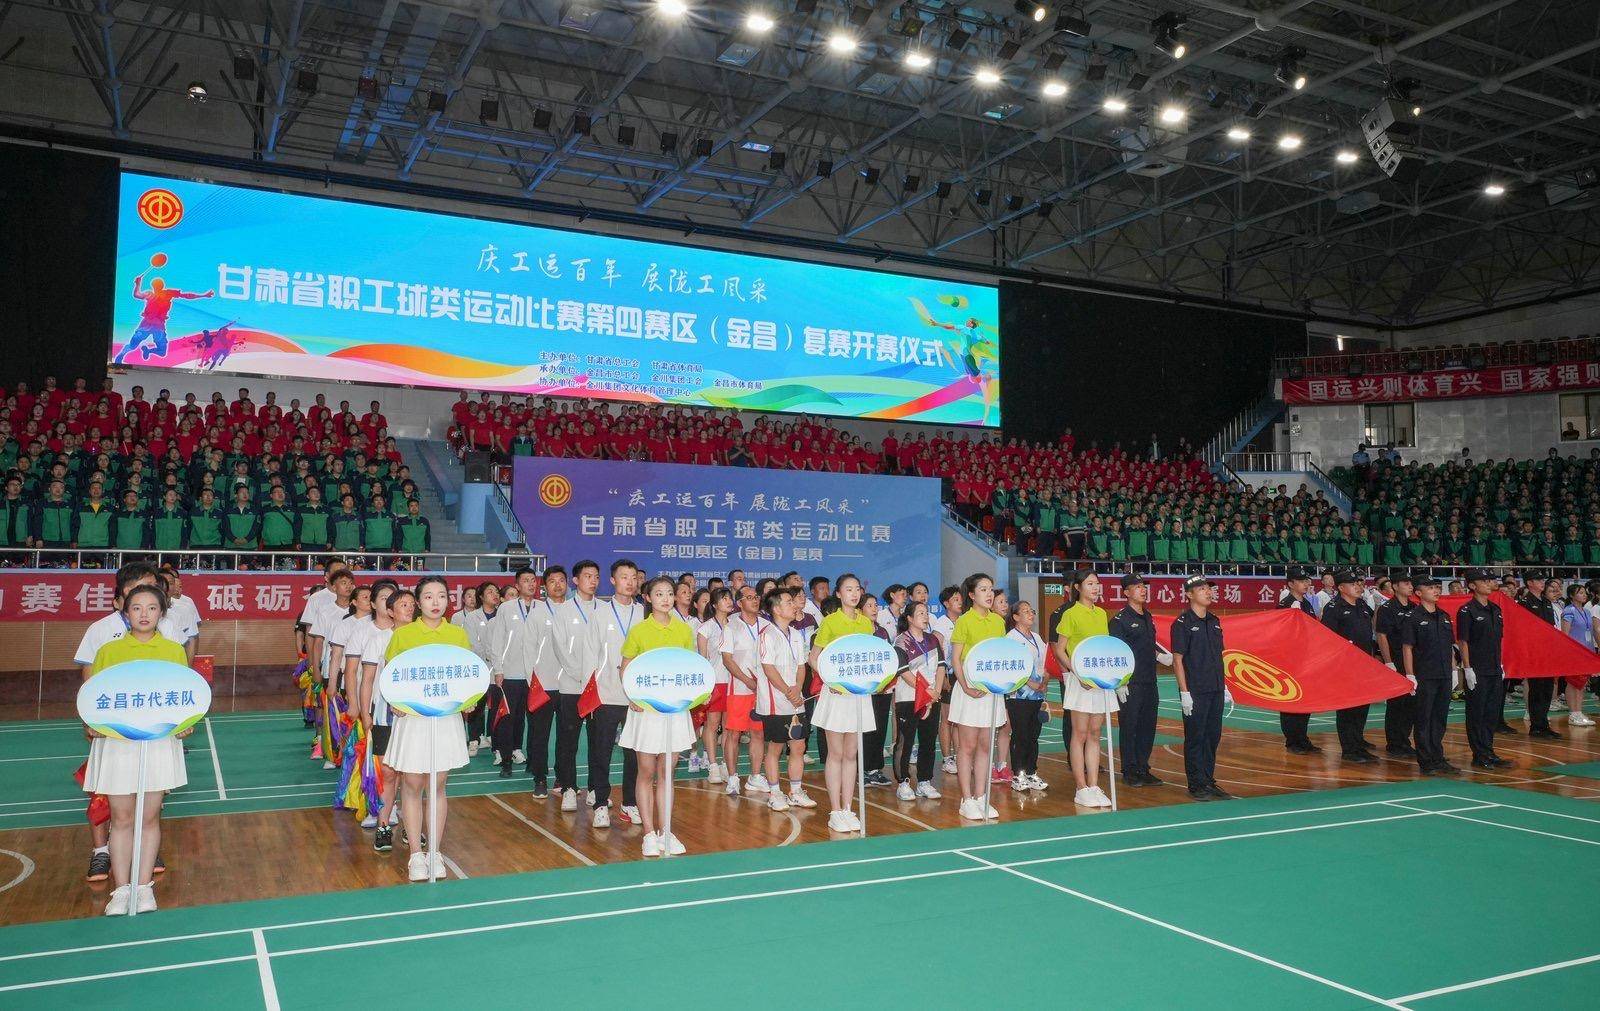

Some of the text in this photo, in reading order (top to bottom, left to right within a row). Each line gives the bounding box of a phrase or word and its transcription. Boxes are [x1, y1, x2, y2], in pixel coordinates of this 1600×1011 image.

[1308, 373, 1482, 400] 国运兴则体育兴
[581, 515, 892, 543] 甘肃省职工球类运动比赛
[976, 658, 1026, 672] 武威市代表队
[1083, 655, 1129, 668] 酒泉市代表队
[392, 664, 480, 682] 金川集团股份有限公司
[838, 665, 884, 677] 分公司代表队
[636, 673, 705, 688] 中铁二十一局代表队
[423, 683, 449, 698] 代表队
[96, 690, 195, 710] 金昌市代表队
